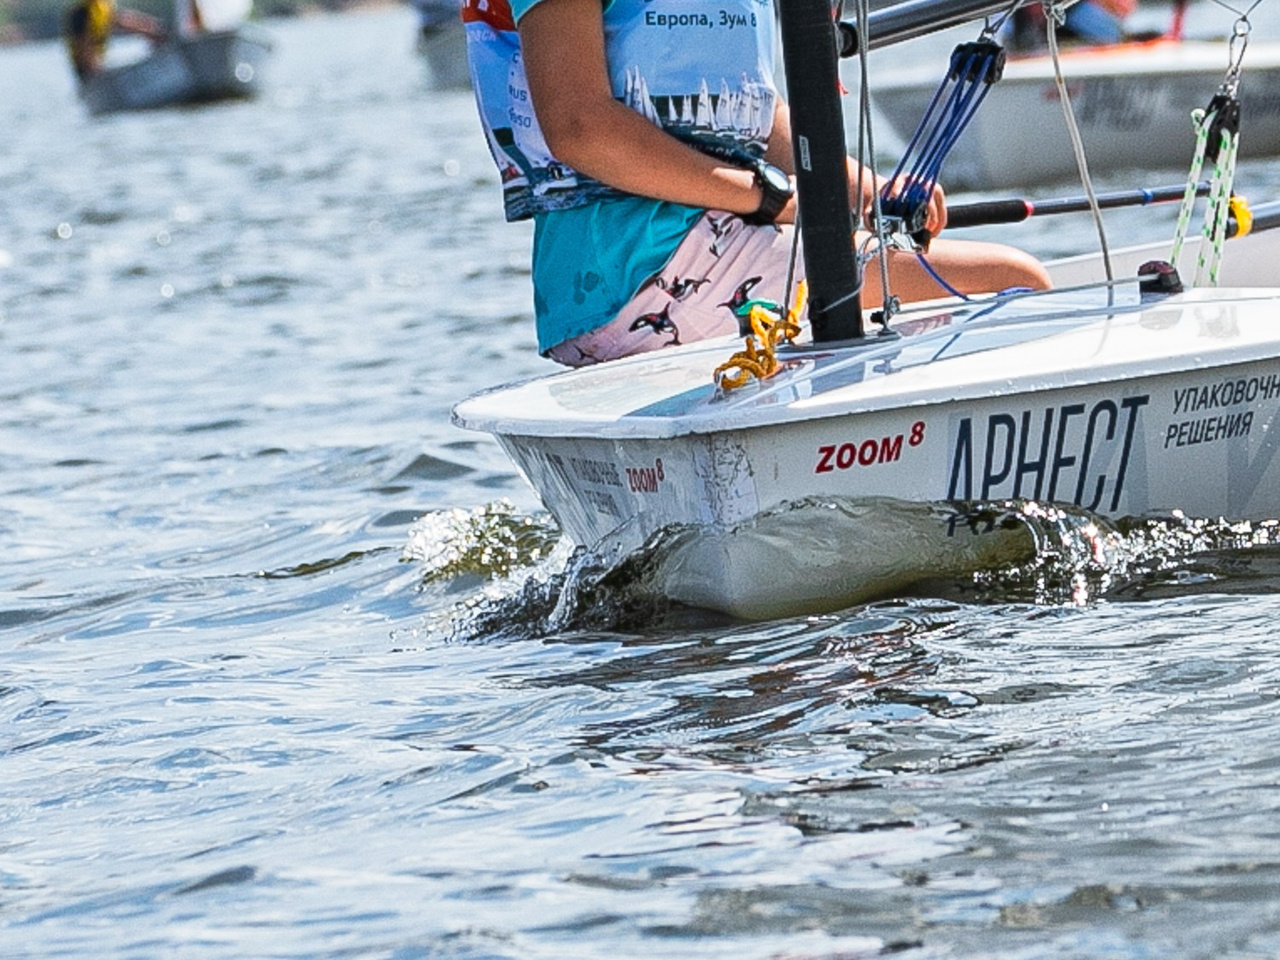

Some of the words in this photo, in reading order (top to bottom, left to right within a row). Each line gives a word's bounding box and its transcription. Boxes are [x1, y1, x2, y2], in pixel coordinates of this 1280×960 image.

[645, 10, 714, 30] Европа,
[719, 10, 747, 30] Зум
[1164, 410, 1256, 449] РЕШЕНИЯ
